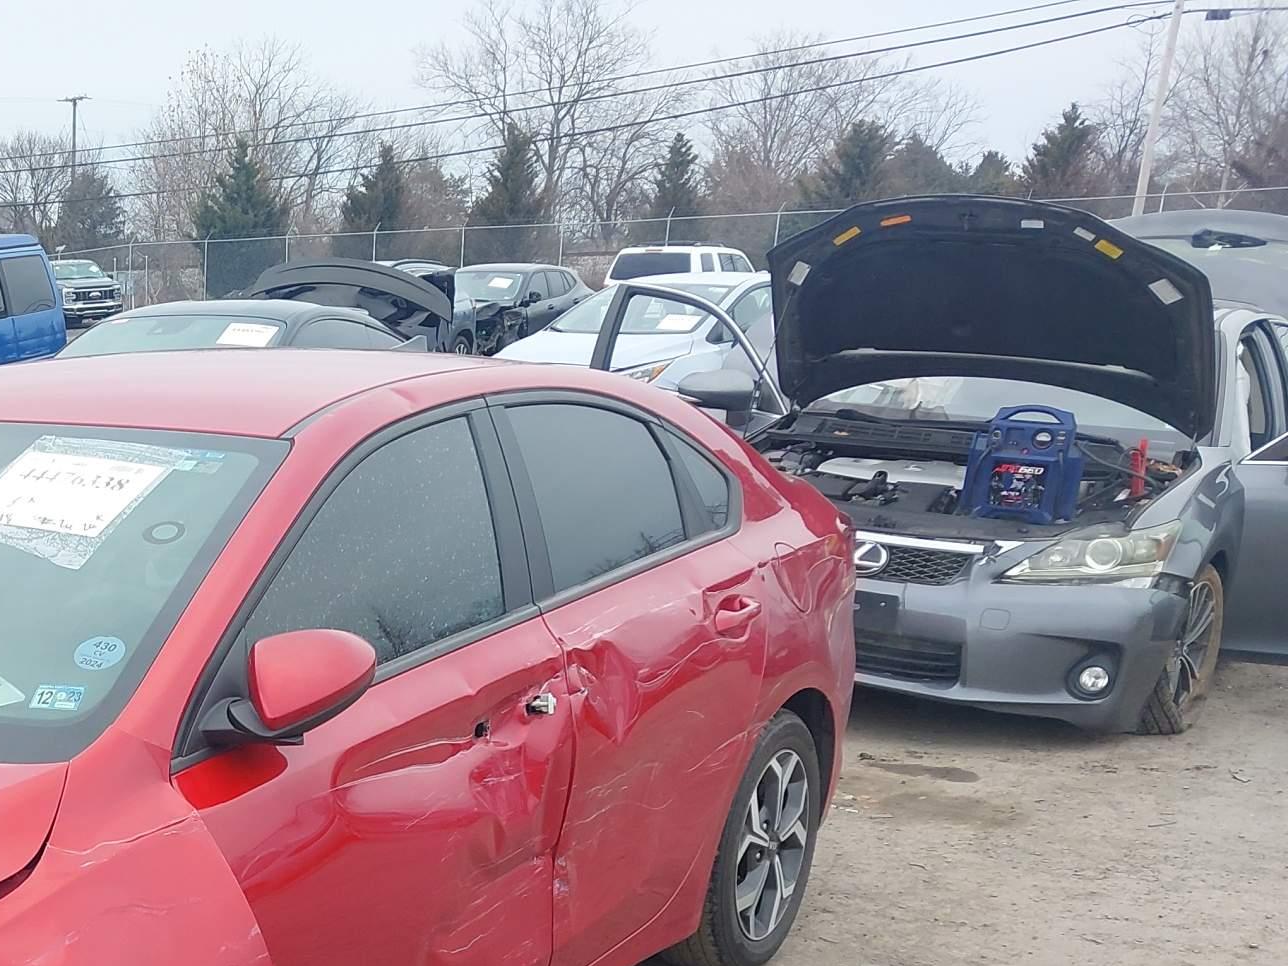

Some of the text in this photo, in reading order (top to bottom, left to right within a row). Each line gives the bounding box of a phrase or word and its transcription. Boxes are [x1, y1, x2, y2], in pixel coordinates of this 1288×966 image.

[93, 640, 117, 653] 430
[79, 657, 104, 668] 2024
[36, 690, 54, 705] 12
[68, 691, 82, 702] 23
